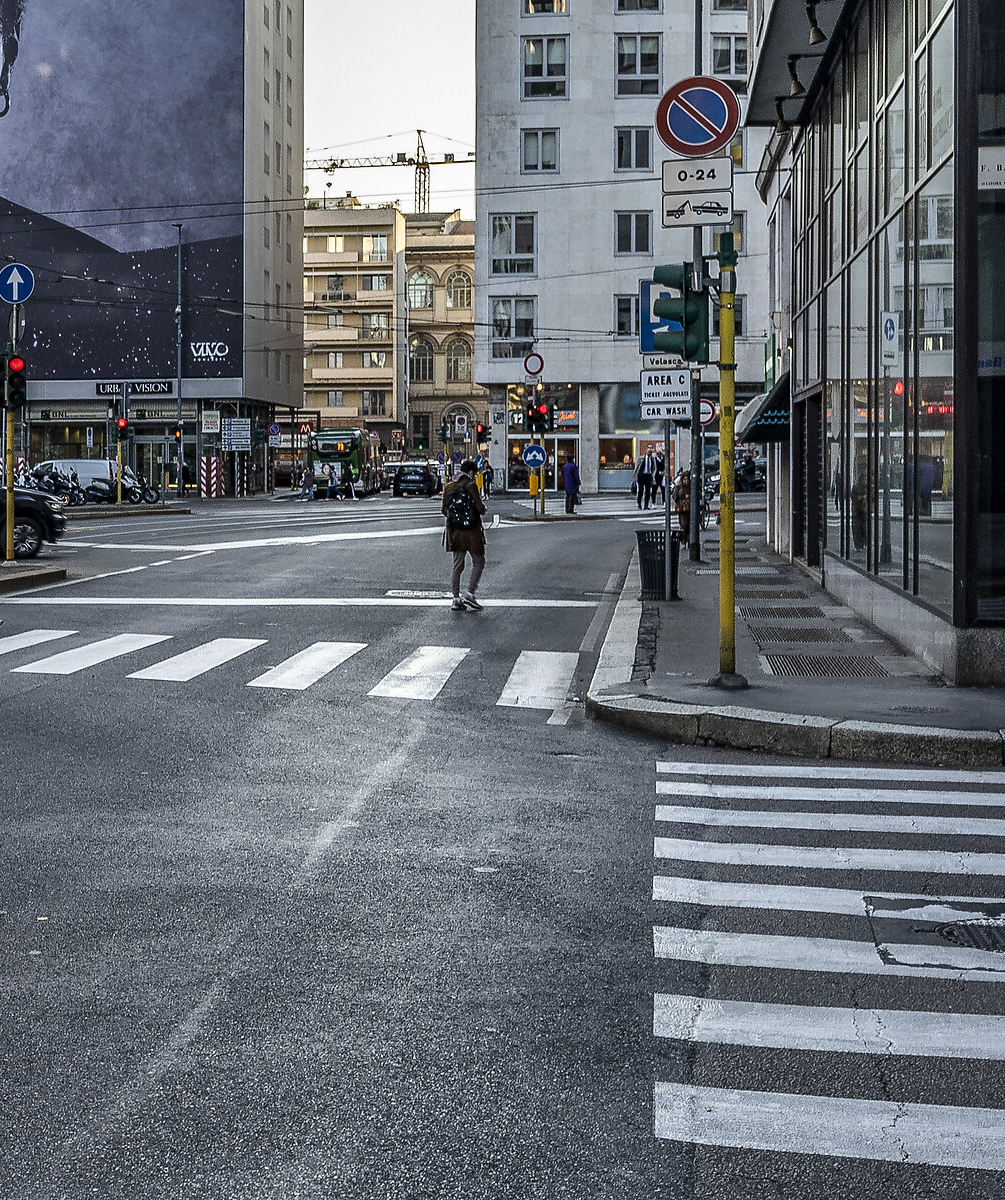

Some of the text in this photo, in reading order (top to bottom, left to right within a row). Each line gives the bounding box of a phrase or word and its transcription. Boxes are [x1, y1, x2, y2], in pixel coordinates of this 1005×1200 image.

[677, 168, 717, 182] 0-24
[190, 342, 229, 357] VIVO
[647, 374, 685, 386] AREA C
[135, 382, 169, 393] VISION
[646, 406, 687, 416] CAR WASH
